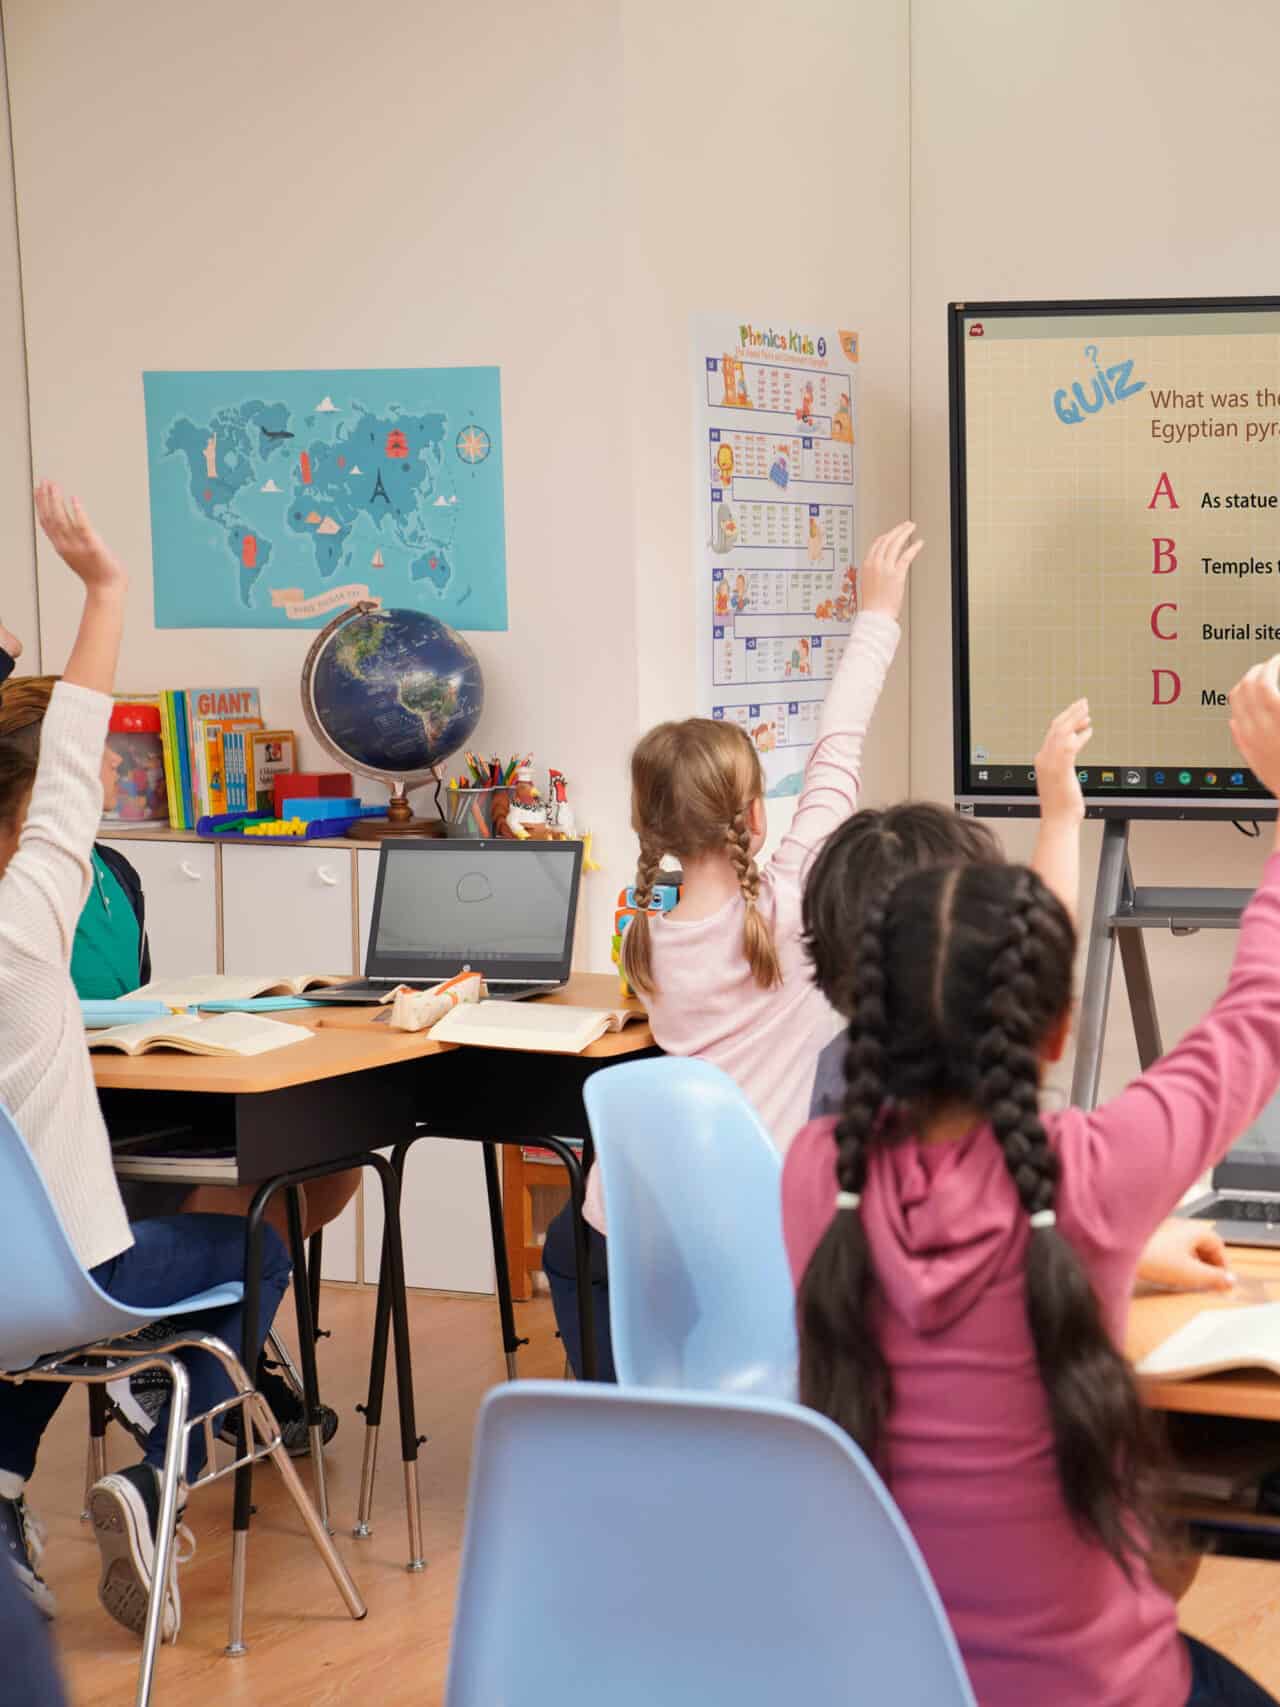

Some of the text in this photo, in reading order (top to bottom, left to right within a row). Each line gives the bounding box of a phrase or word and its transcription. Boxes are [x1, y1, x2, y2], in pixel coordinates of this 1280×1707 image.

[739, 324, 787, 351] Phonics
[788, 328, 815, 356] Kids
[1150, 390, 1204, 409] What
[1211, 393, 1249, 408] was
[1152, 417, 1238, 444] Egyptian
[1147, 472, 1180, 509] A
[1201, 492, 1221, 509] As
[1225, 491, 1279, 509] statue
[1151, 537, 1178, 574] B
[1201, 557, 1273, 578] Temples
[1150, 602, 1178, 640] C
[1203, 624, 1251, 641] Burial
[198, 692, 251, 715] GIANT
[1151, 669, 1182, 705] D
